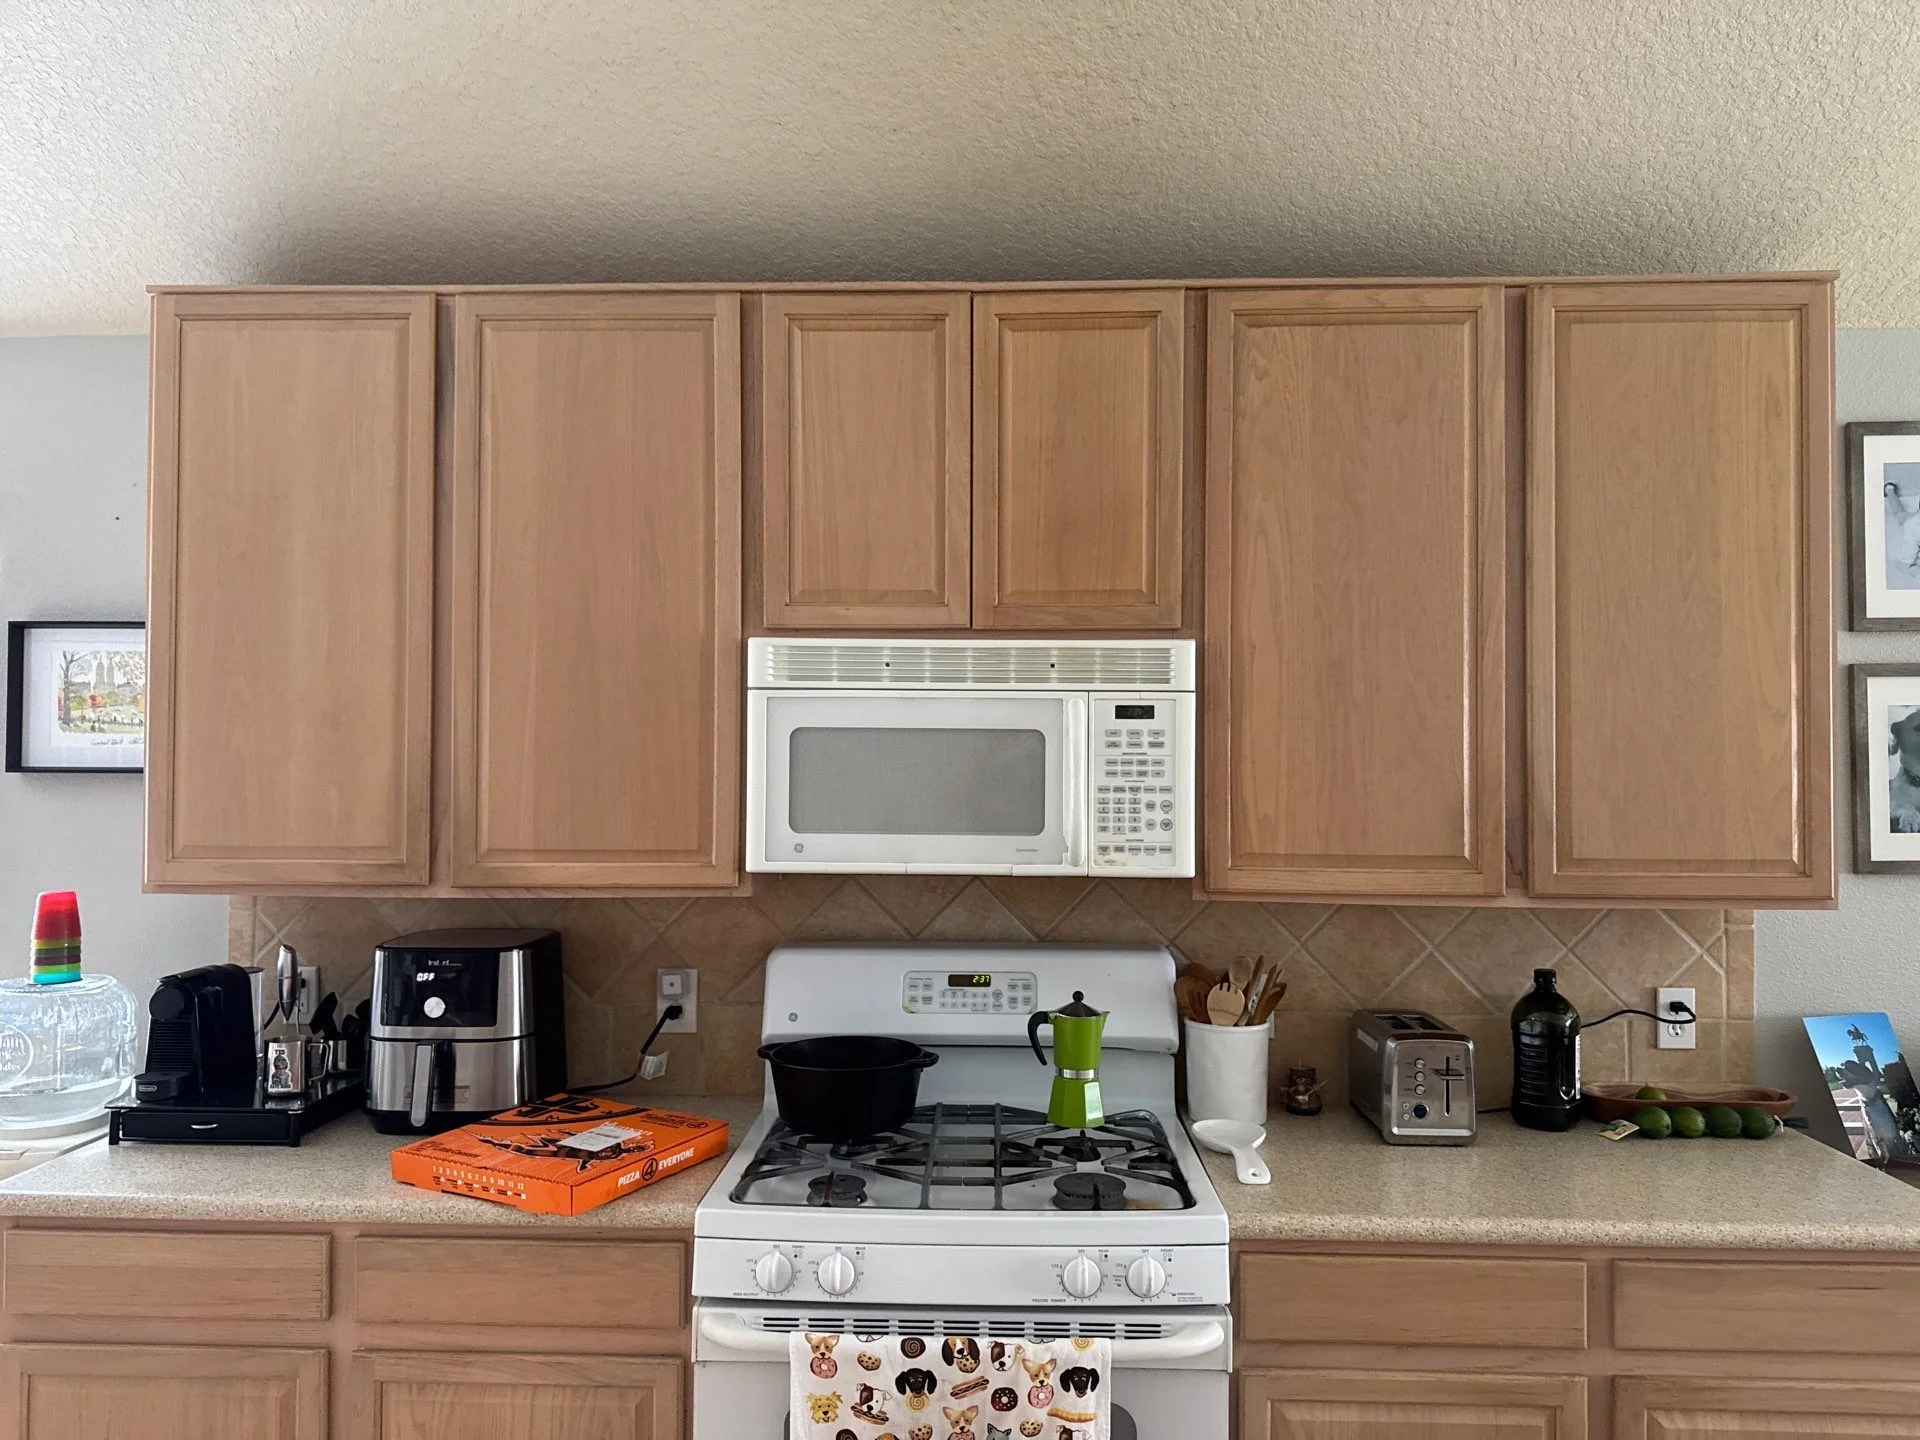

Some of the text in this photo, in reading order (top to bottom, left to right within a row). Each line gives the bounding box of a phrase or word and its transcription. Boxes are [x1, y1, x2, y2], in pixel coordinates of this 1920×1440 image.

[417, 972, 435, 981] OFF
[973, 975, 990, 983] 2:37
[618, 1147, 694, 1187] PIZZA 4 EVERYONE
